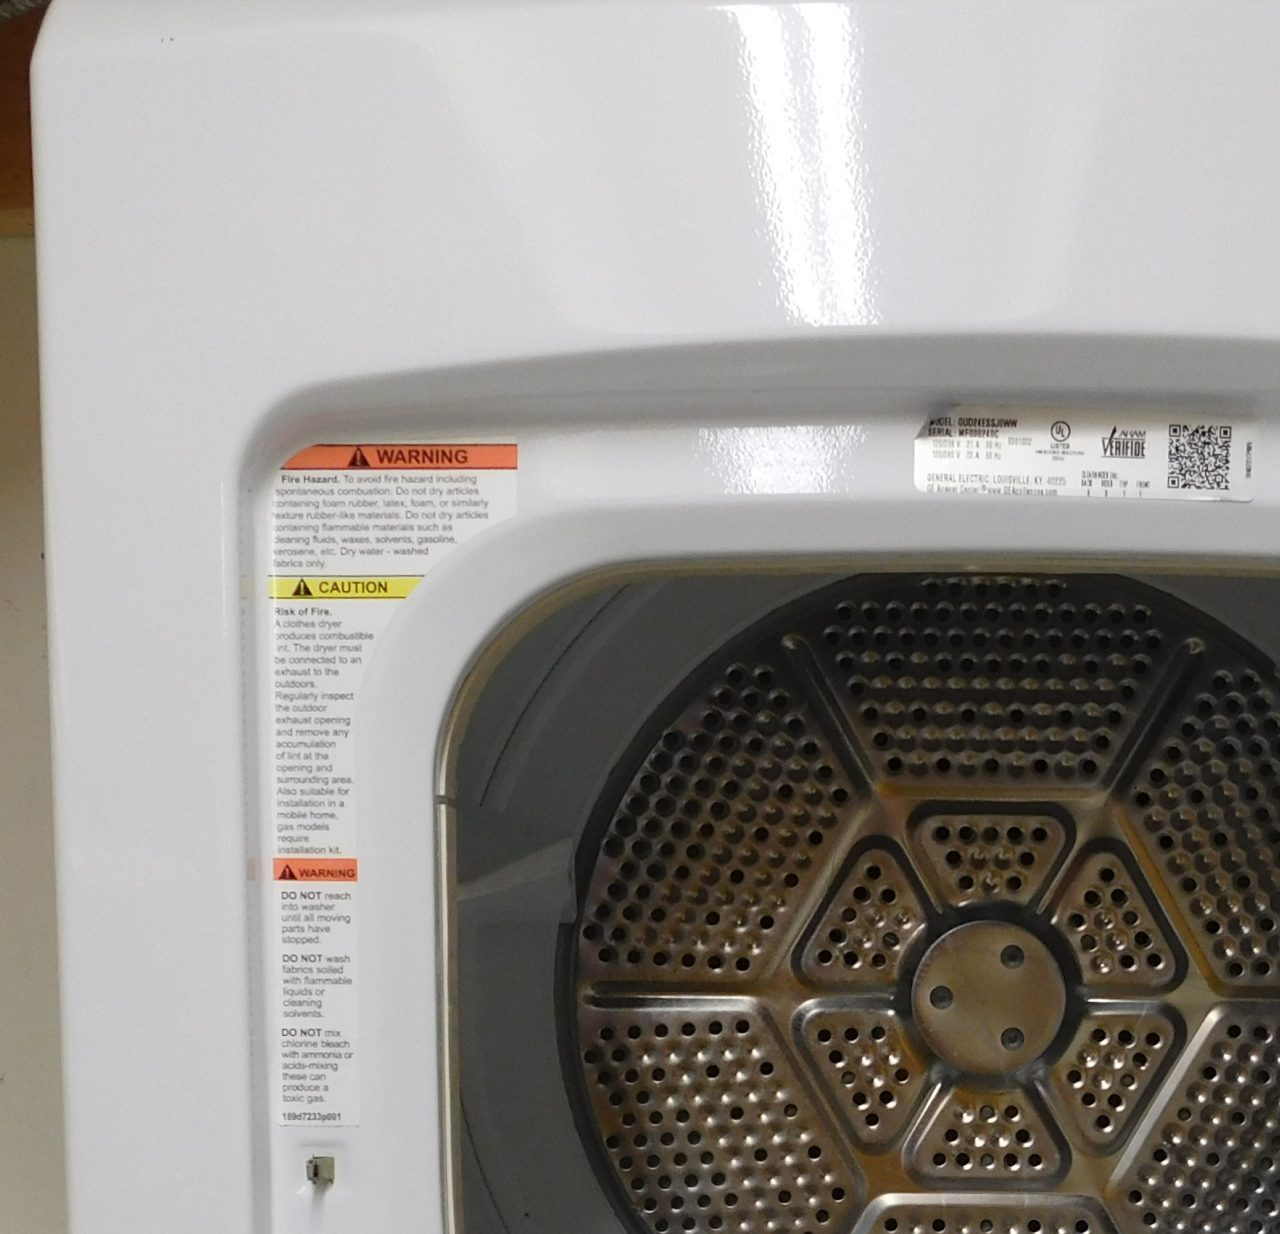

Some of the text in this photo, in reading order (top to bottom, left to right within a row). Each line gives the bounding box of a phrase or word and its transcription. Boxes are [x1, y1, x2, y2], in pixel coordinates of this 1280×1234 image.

[376, 449, 467, 464] WARNING
[282, 474, 477, 485] Fire Hazard. To avoid fire hazard including
[927, 473, 956, 483] GENERAL
[396, 486, 409, 495] Do
[412, 487, 427, 495] not
[429, 487, 443, 497] dry
[446, 487, 479, 495] articles
[319, 581, 387, 593] CAUTION
[275, 607, 332, 616] Risk of Fire.
[299, 868, 355, 878] WARNING
[281, 891, 351, 900] DO NOT reach
[283, 954, 350, 963] DO NOT wash
[282, 1028, 297, 1036] DO
[300, 1028, 322, 1037] NOT
